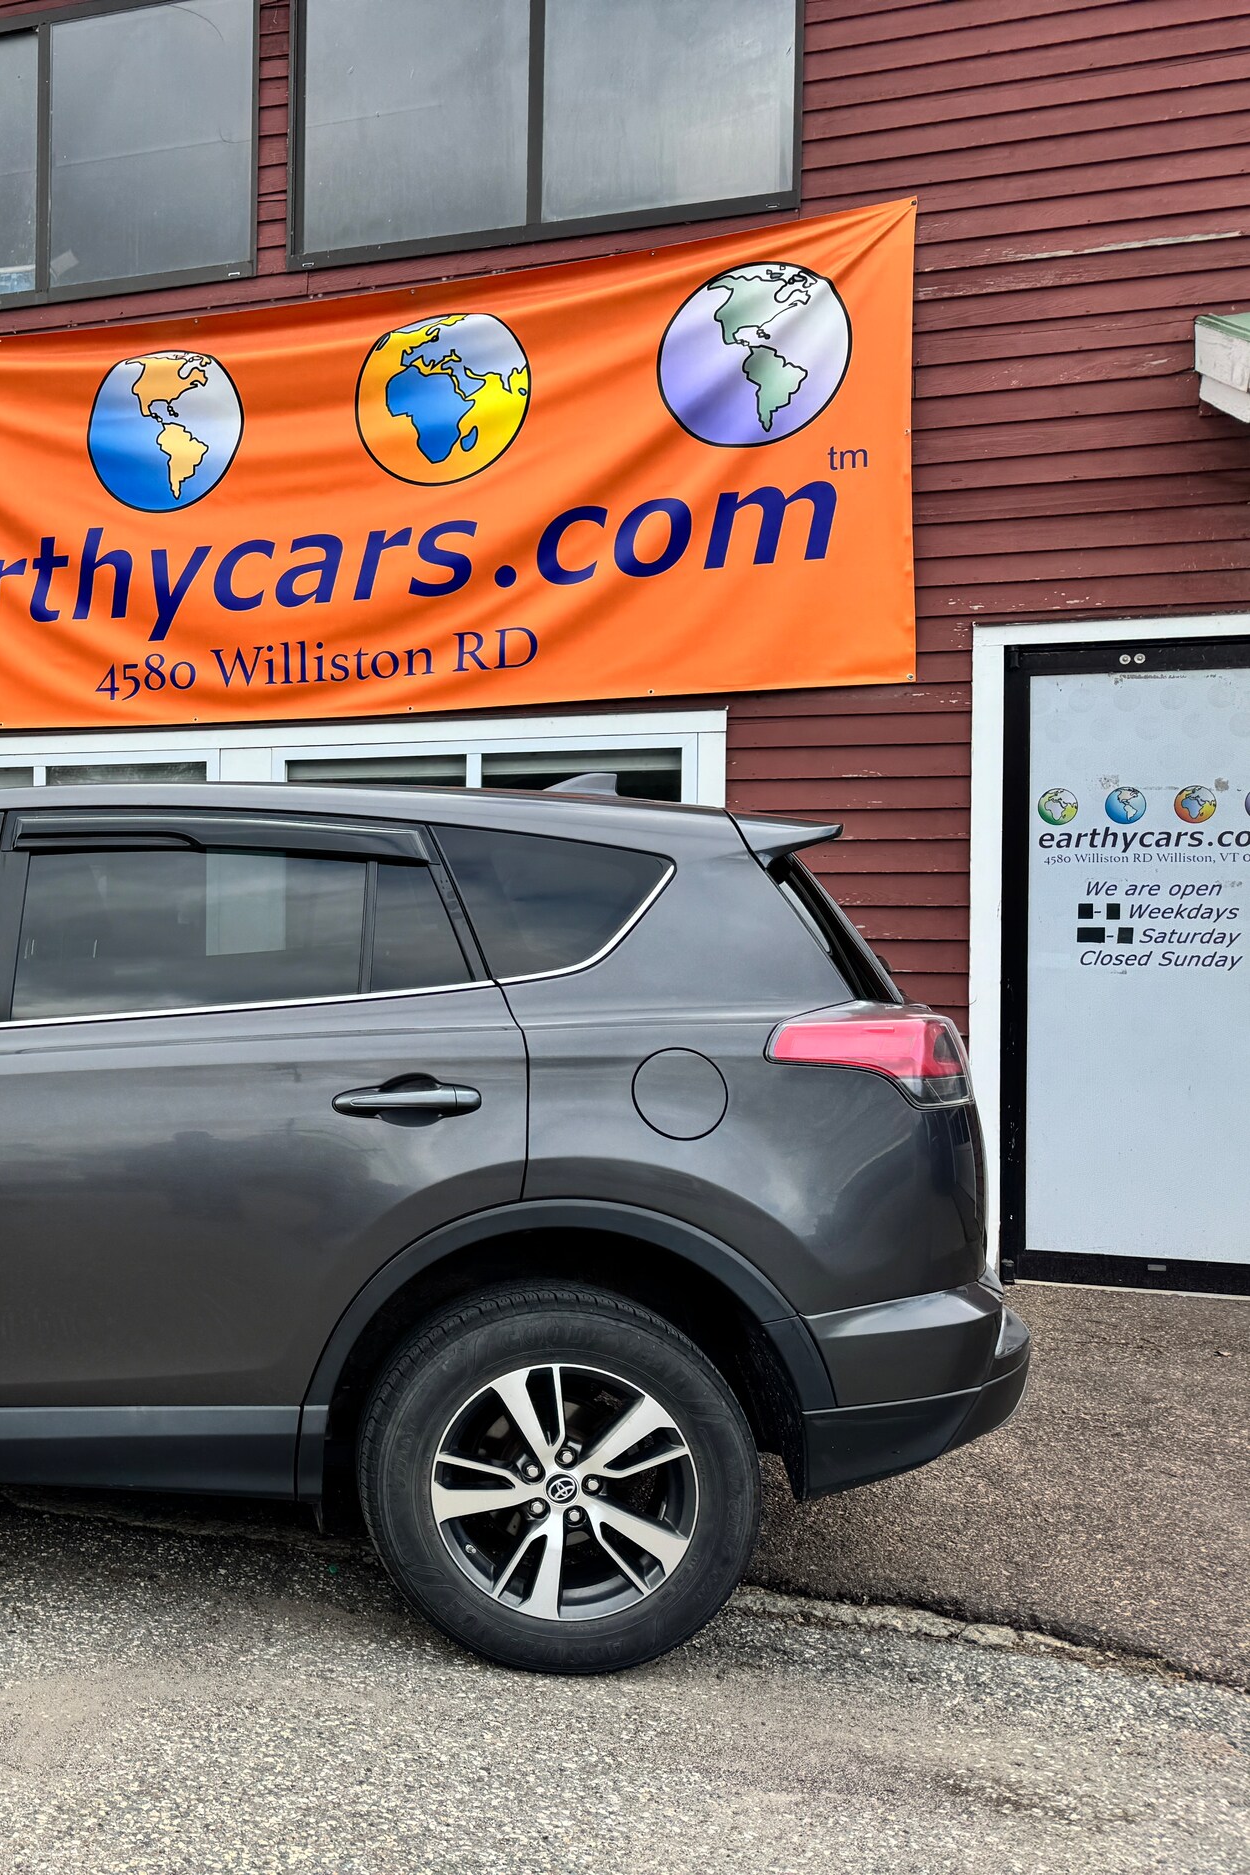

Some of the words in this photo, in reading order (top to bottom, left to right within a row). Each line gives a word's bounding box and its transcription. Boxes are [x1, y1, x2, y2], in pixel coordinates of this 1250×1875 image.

[827, 446, 869, 470] tm
[94, 652, 197, 701] 4580
[209, 641, 435, 689] Williston
[452, 626, 539, 673] RD
[1043, 853, 1071, 866] 4580
[1075, 852, 1129, 864] Williston
[1132, 852, 1153, 863] RD
[1157, 852, 1216, 864] Williston,
[1219, 852, 1240, 863] VT
[1086, 880, 1118, 896] We
[1124, 882, 1161, 897] are
[1168, 882, 1223, 900] open
[1129, 903, 1240, 924] Weekdays
[1139, 928, 1242, 949] Saturday
[1079, 949, 1153, 967] Closed
[1158, 950, 1244, 972] Sunday
